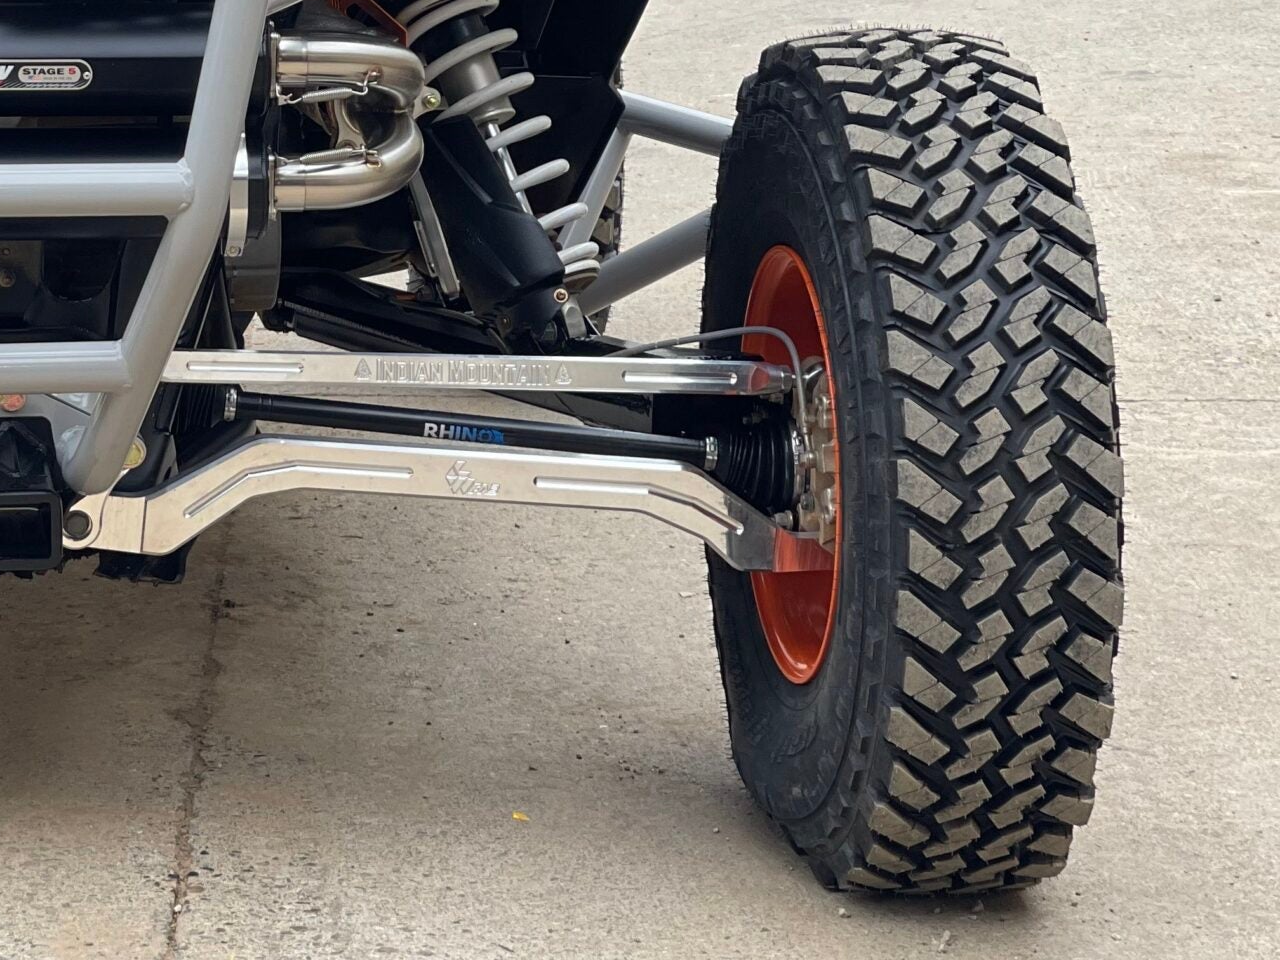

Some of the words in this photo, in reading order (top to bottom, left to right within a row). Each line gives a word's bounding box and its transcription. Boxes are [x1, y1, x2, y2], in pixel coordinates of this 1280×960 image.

[22, 67, 65, 75] STAGE
[68, 67, 76, 75] 5
[376, 358, 443, 384] INDIAN
[447, 360, 550, 386] MOUNTAIN
[423, 422, 498, 443] RHINO
